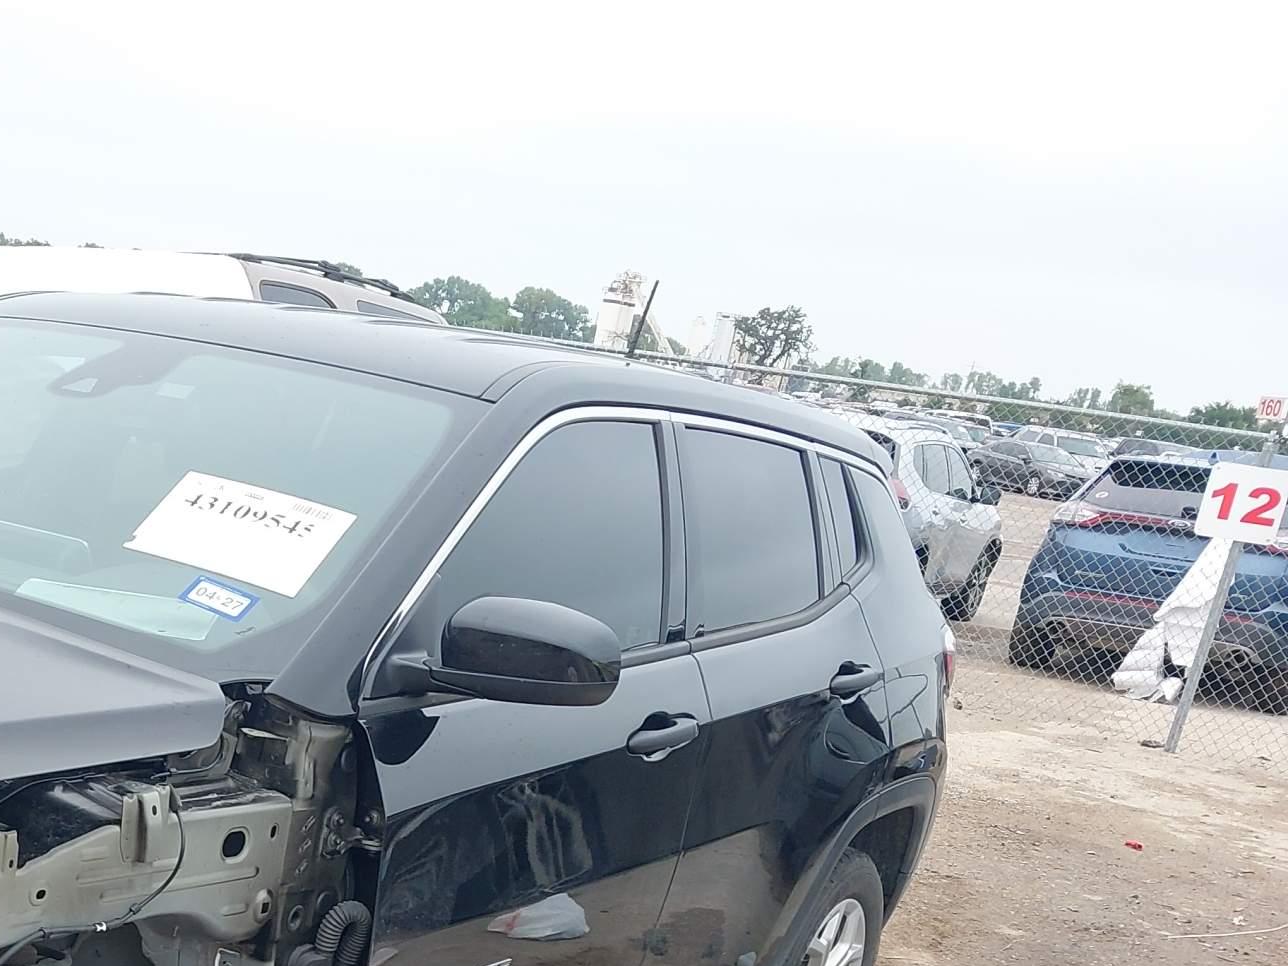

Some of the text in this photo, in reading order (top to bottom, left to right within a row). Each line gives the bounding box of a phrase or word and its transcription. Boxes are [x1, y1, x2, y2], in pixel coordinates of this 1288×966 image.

[1261, 399, 1283, 417] 160
[184, 493, 315, 538] 43109545
[1211, 482, 1282, 528] 12
